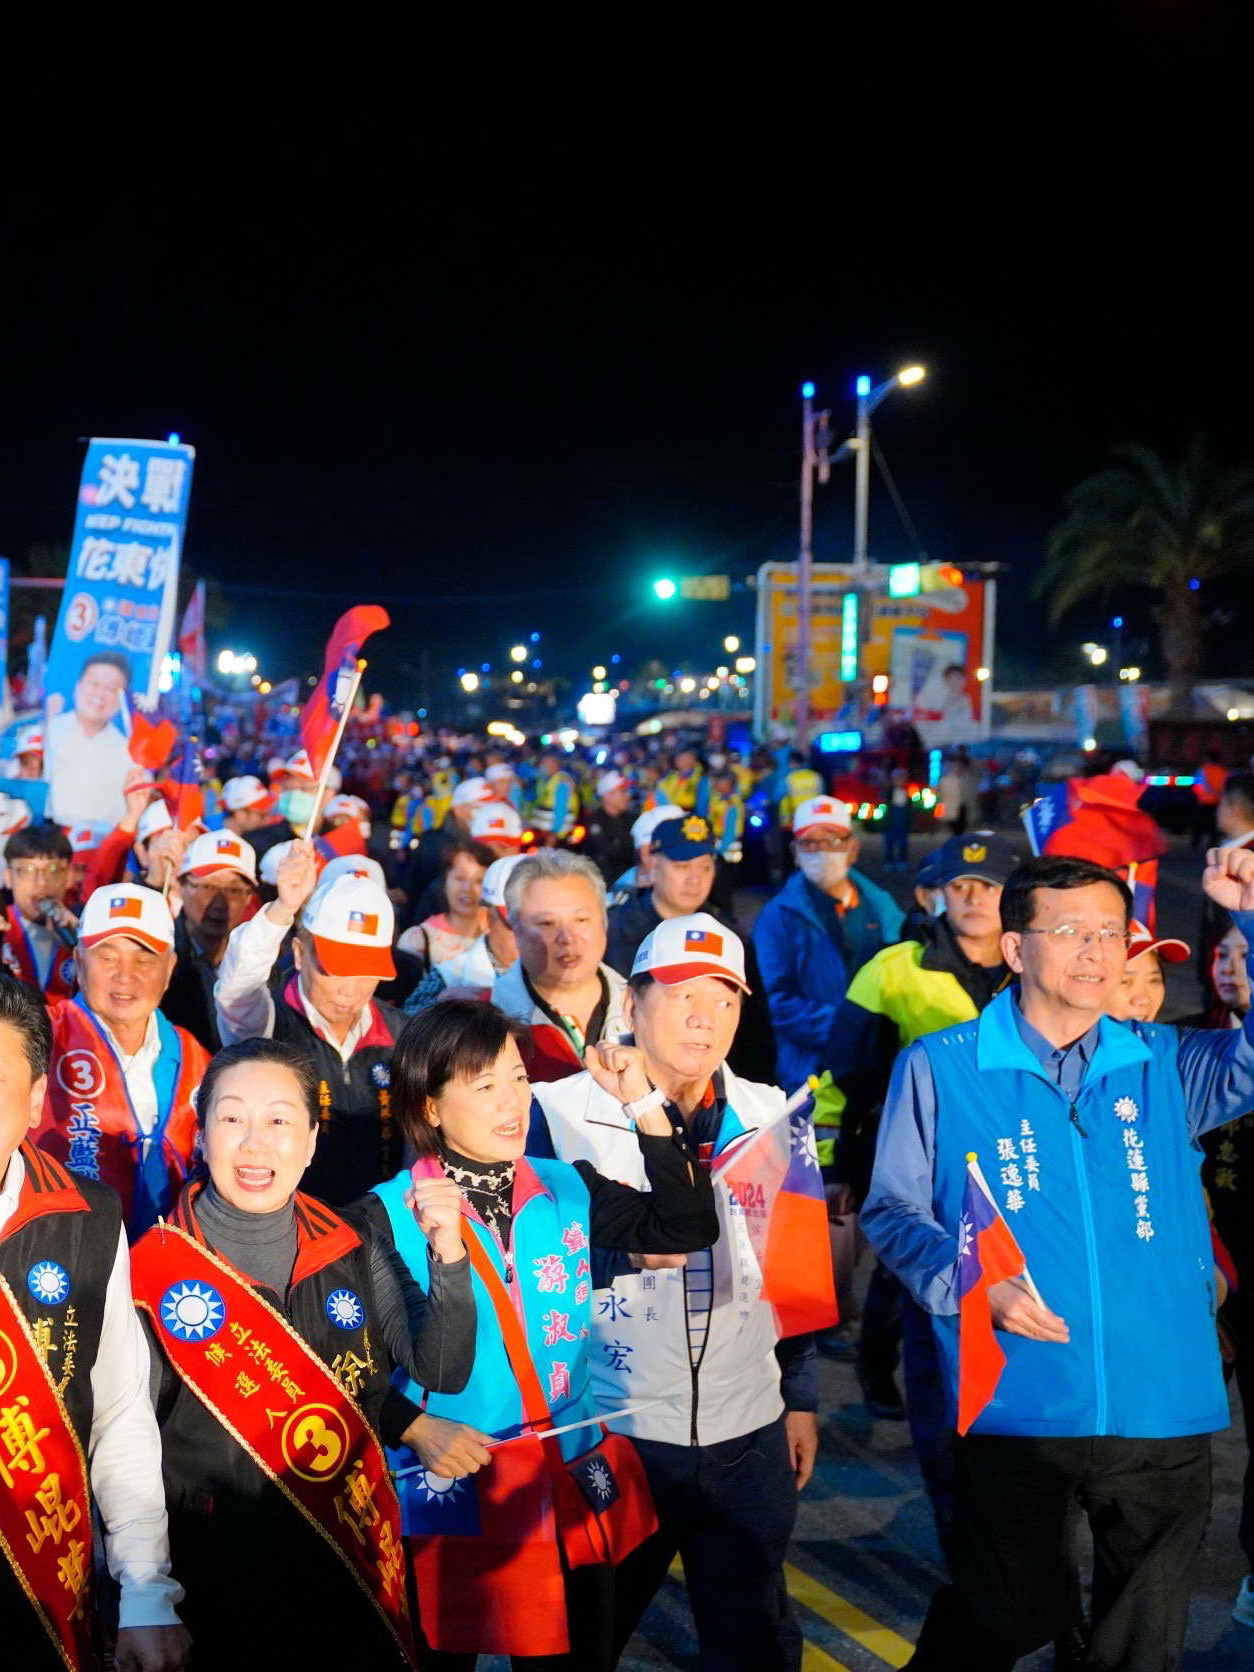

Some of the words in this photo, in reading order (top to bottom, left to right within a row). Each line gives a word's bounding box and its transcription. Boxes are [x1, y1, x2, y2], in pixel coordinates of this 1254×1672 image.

[997, 1137, 1026, 1213] 張逸華
[1019, 1119, 1042, 1192] 主任委員
[1122, 1128, 1155, 1243] 花蓮縣黨部
[228, 1321, 307, 1405] 立法委員
